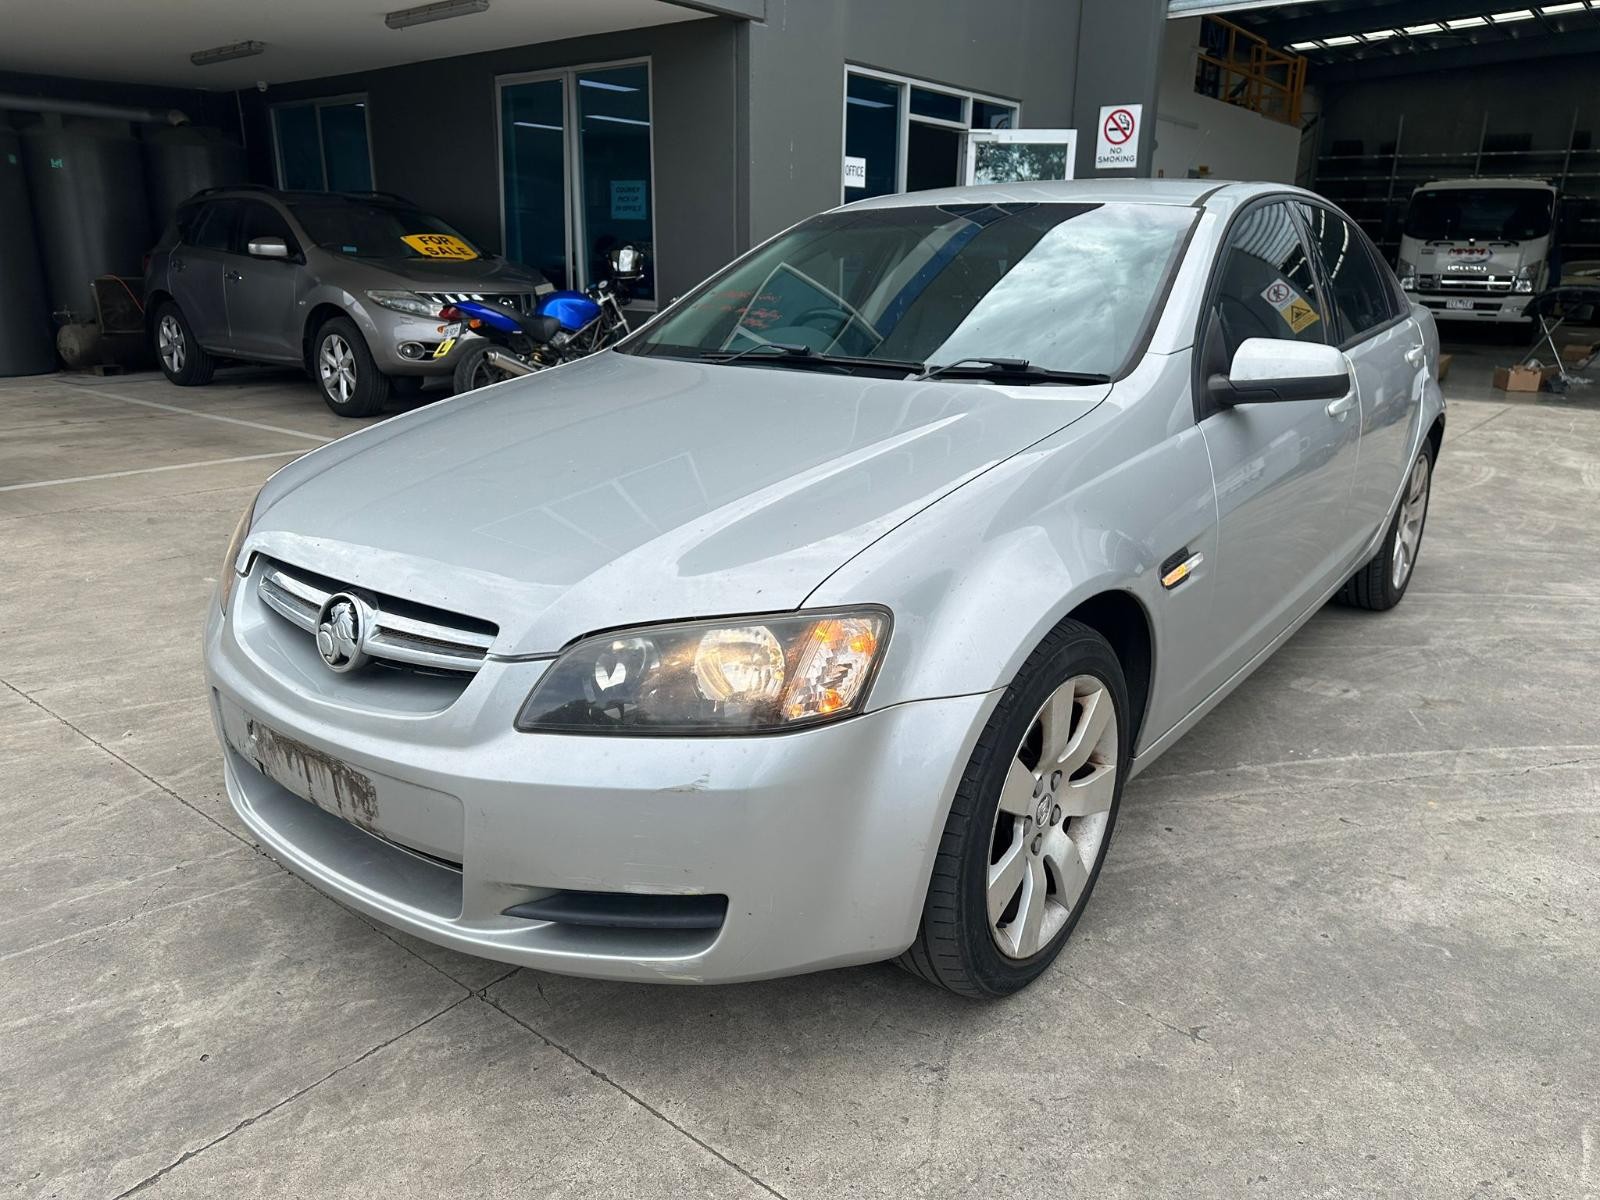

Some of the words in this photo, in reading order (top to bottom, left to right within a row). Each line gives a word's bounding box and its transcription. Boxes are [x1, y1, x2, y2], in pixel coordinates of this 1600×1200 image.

[1109, 147, 1122, 155] NO
[1097, 155, 1135, 164] SMOKING
[844, 164, 864, 178] OFFICE
[417, 235, 453, 246] FOR
[424, 246, 473, 256] SALE
